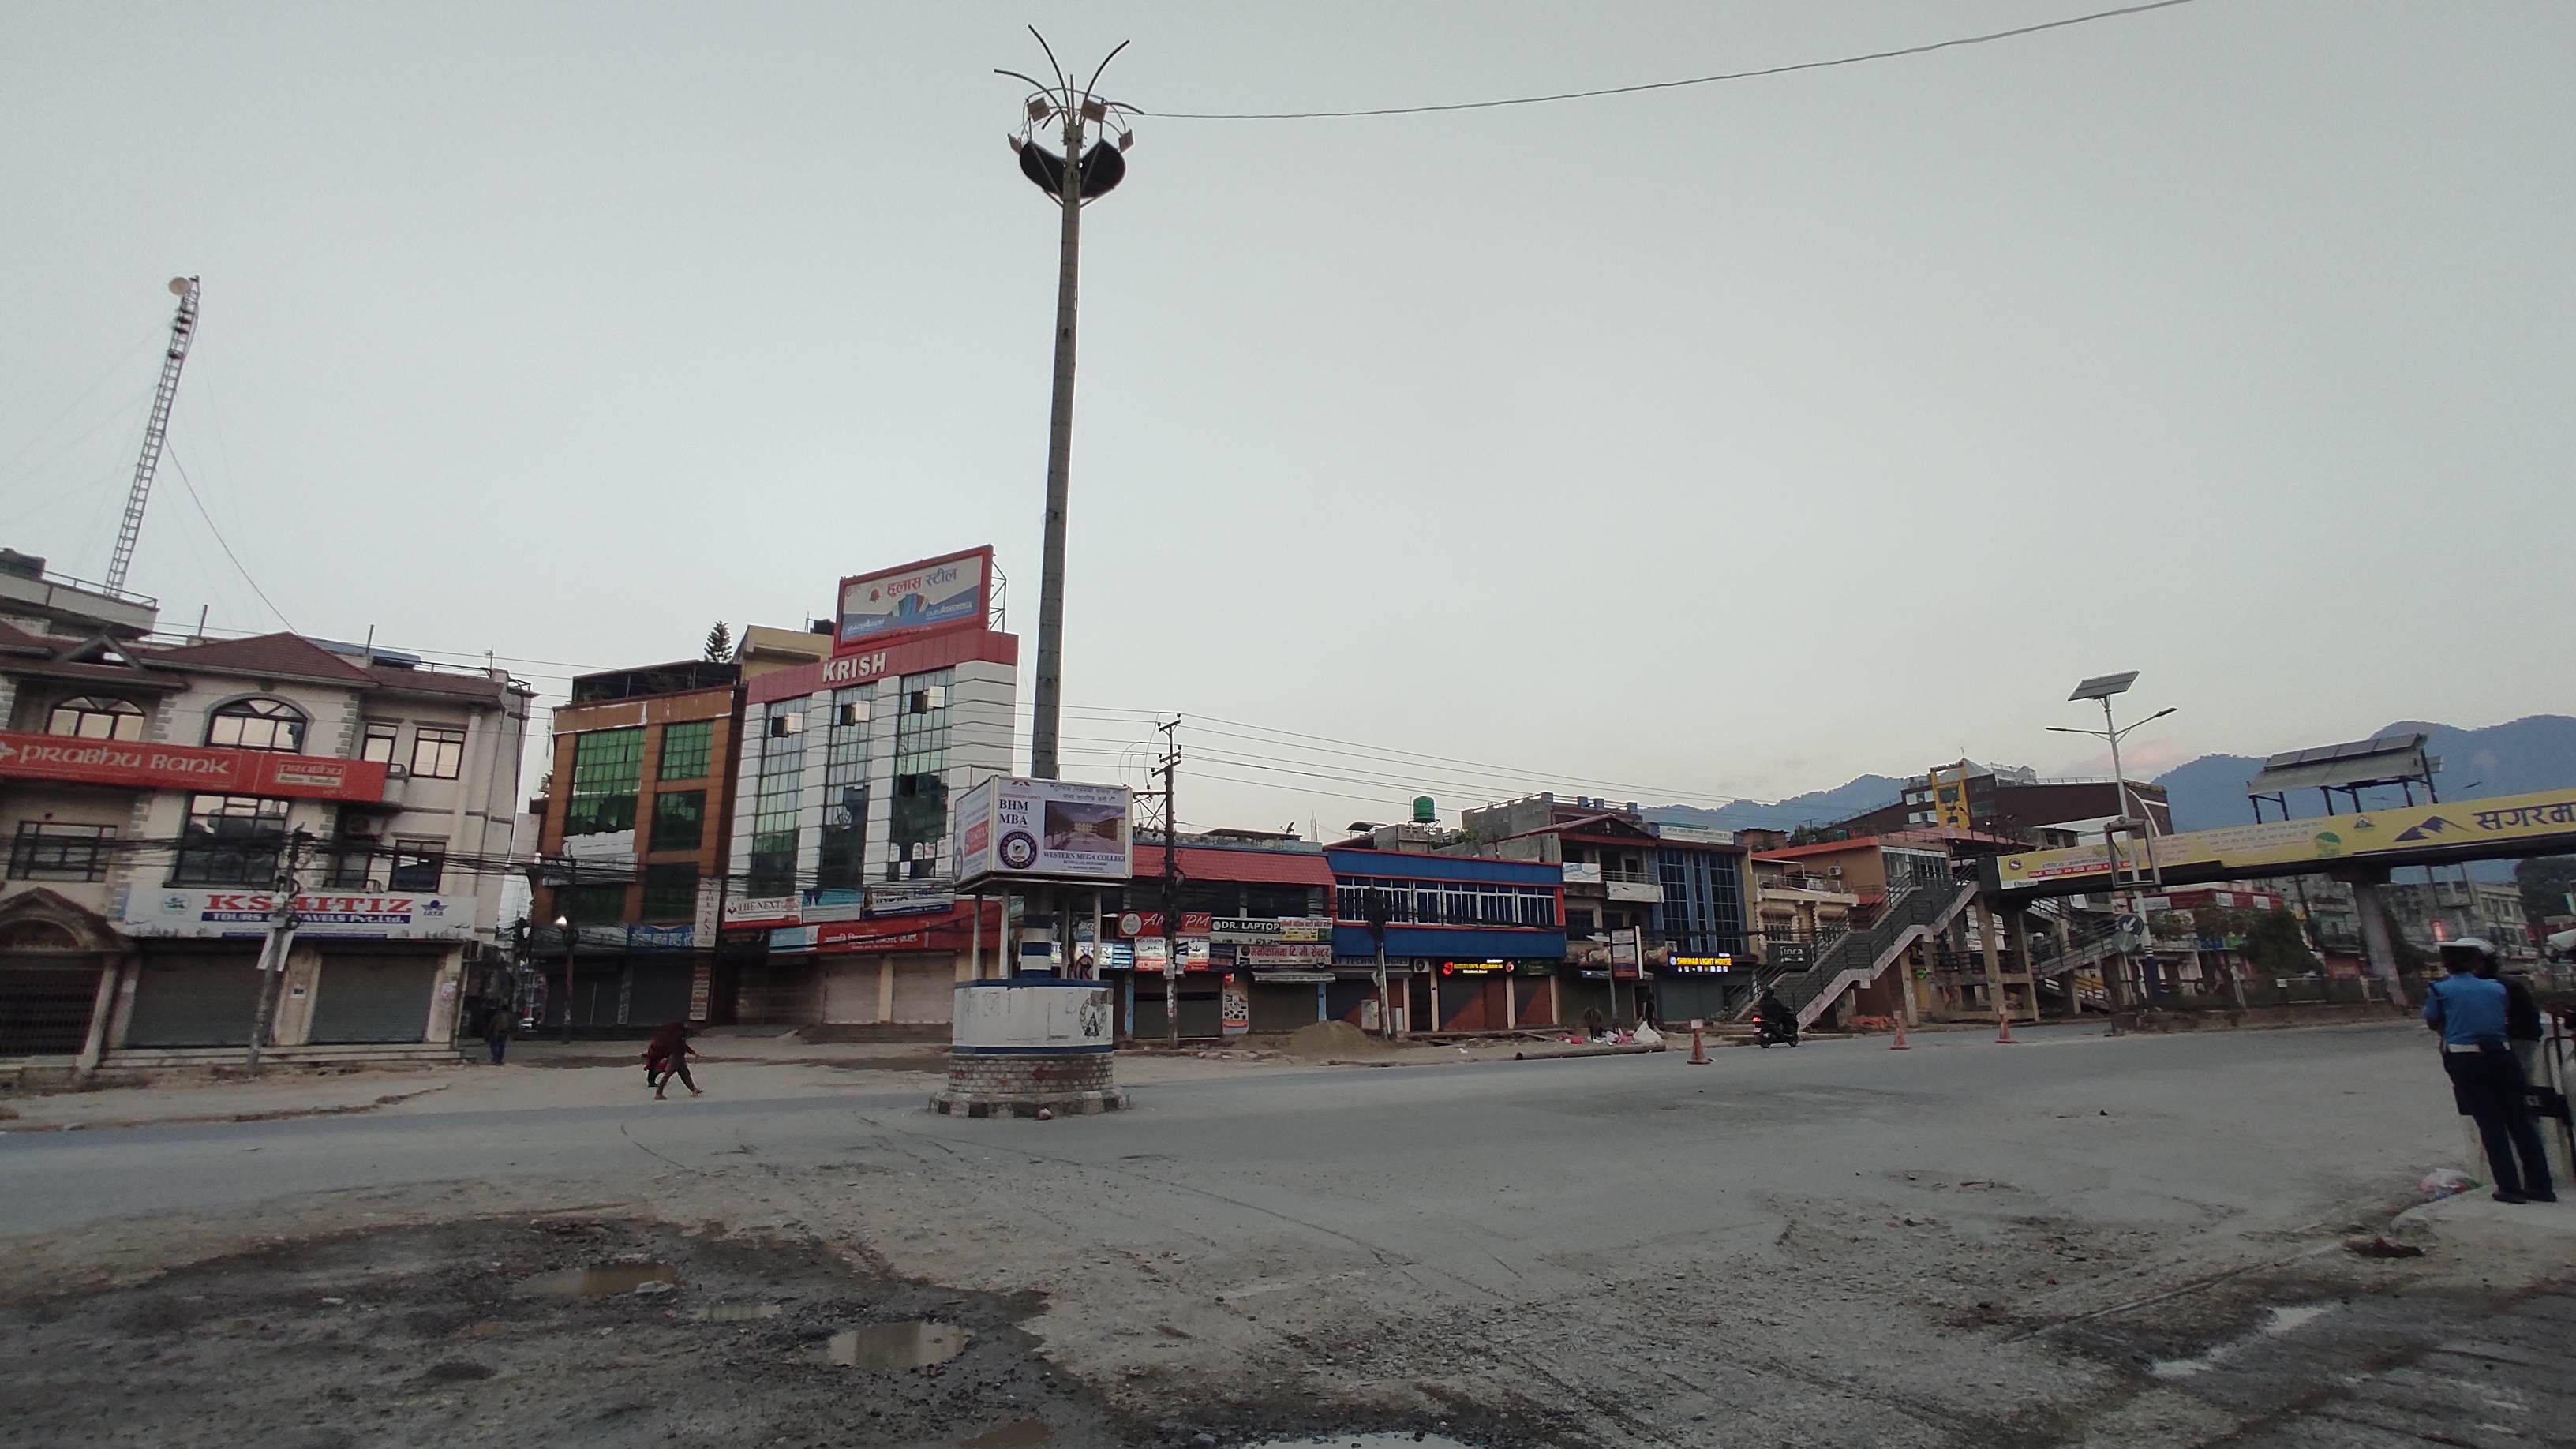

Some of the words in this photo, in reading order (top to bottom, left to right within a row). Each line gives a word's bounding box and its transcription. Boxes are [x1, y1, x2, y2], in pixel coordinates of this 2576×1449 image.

[926, 567, 957, 587] स्टील
[822, 652, 886, 683] KRISH
[999, 799, 1028, 811] BHM
[999, 814, 1028, 825] MBA
[213, 912, 262, 922] TOURS
[1185, 914, 1210, 927] PM
[1242, 922, 1280, 930] LAPTOP
